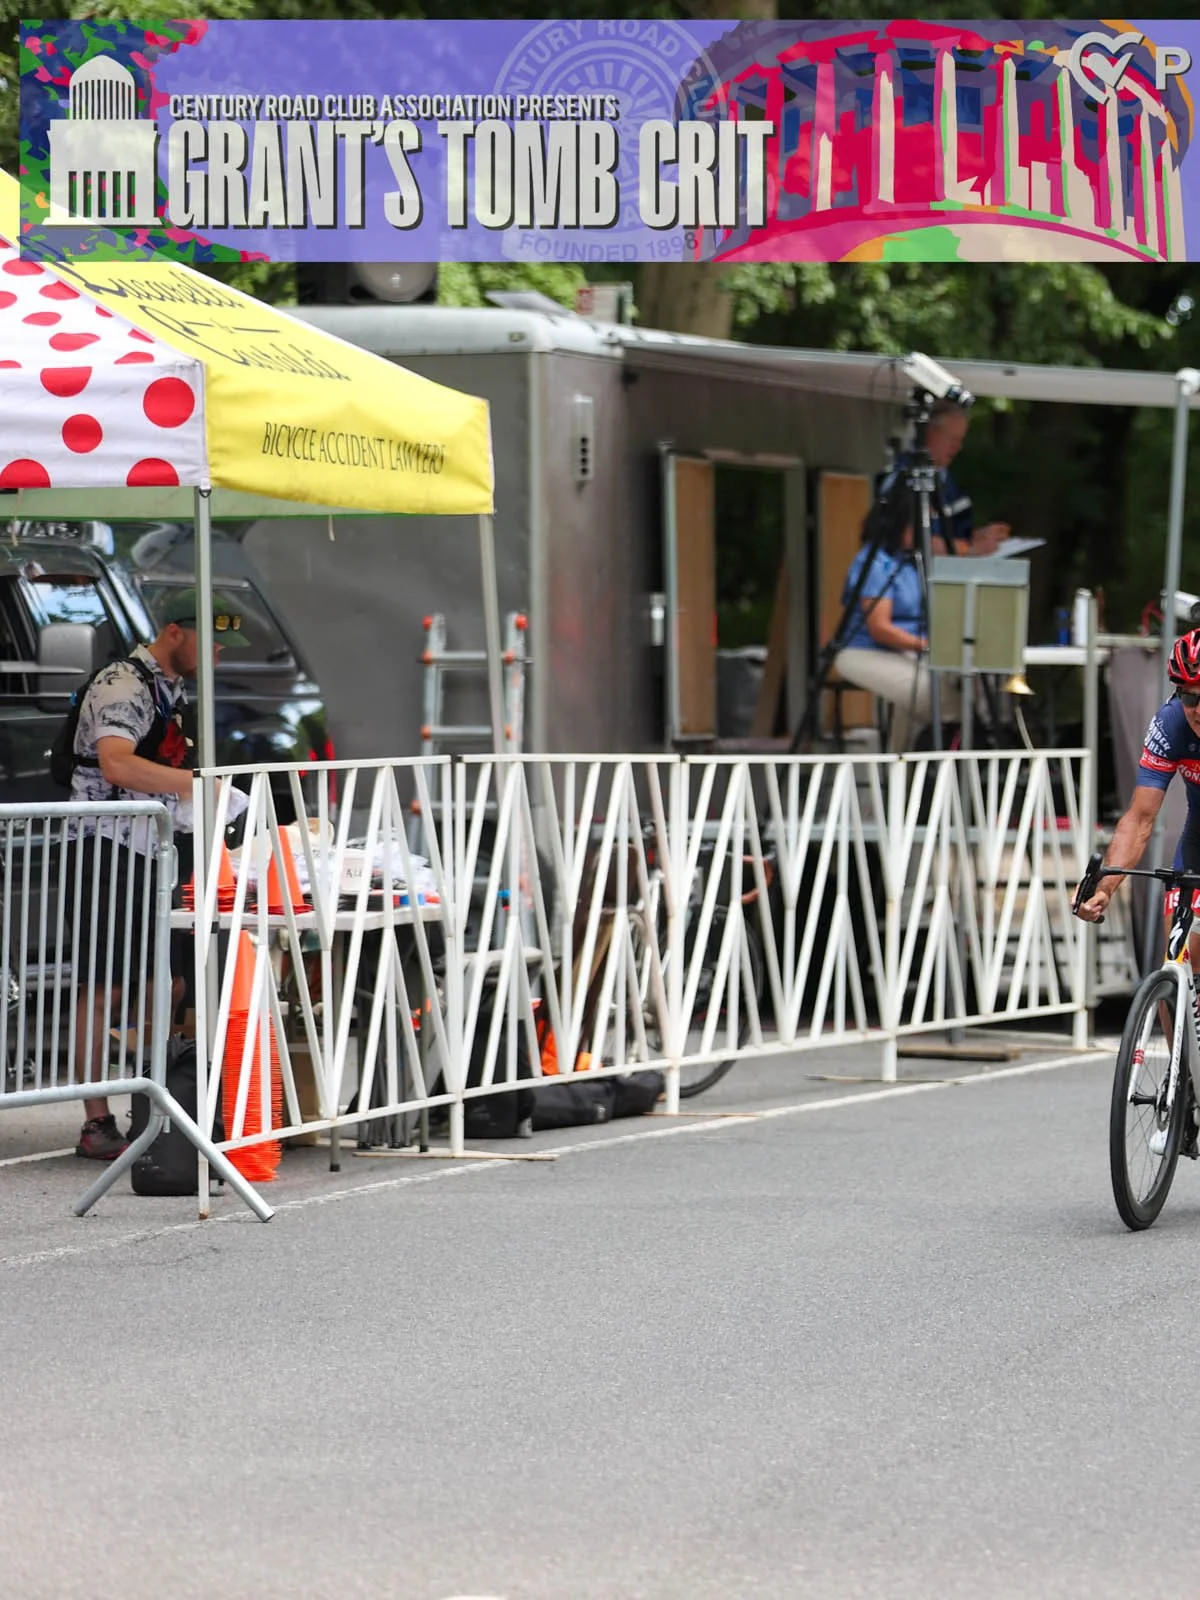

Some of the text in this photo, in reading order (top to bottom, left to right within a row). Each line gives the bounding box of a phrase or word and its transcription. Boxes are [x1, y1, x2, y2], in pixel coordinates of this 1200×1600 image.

[261, 421, 447, 475] BICYCLE ACCIDENT LAWYERS
